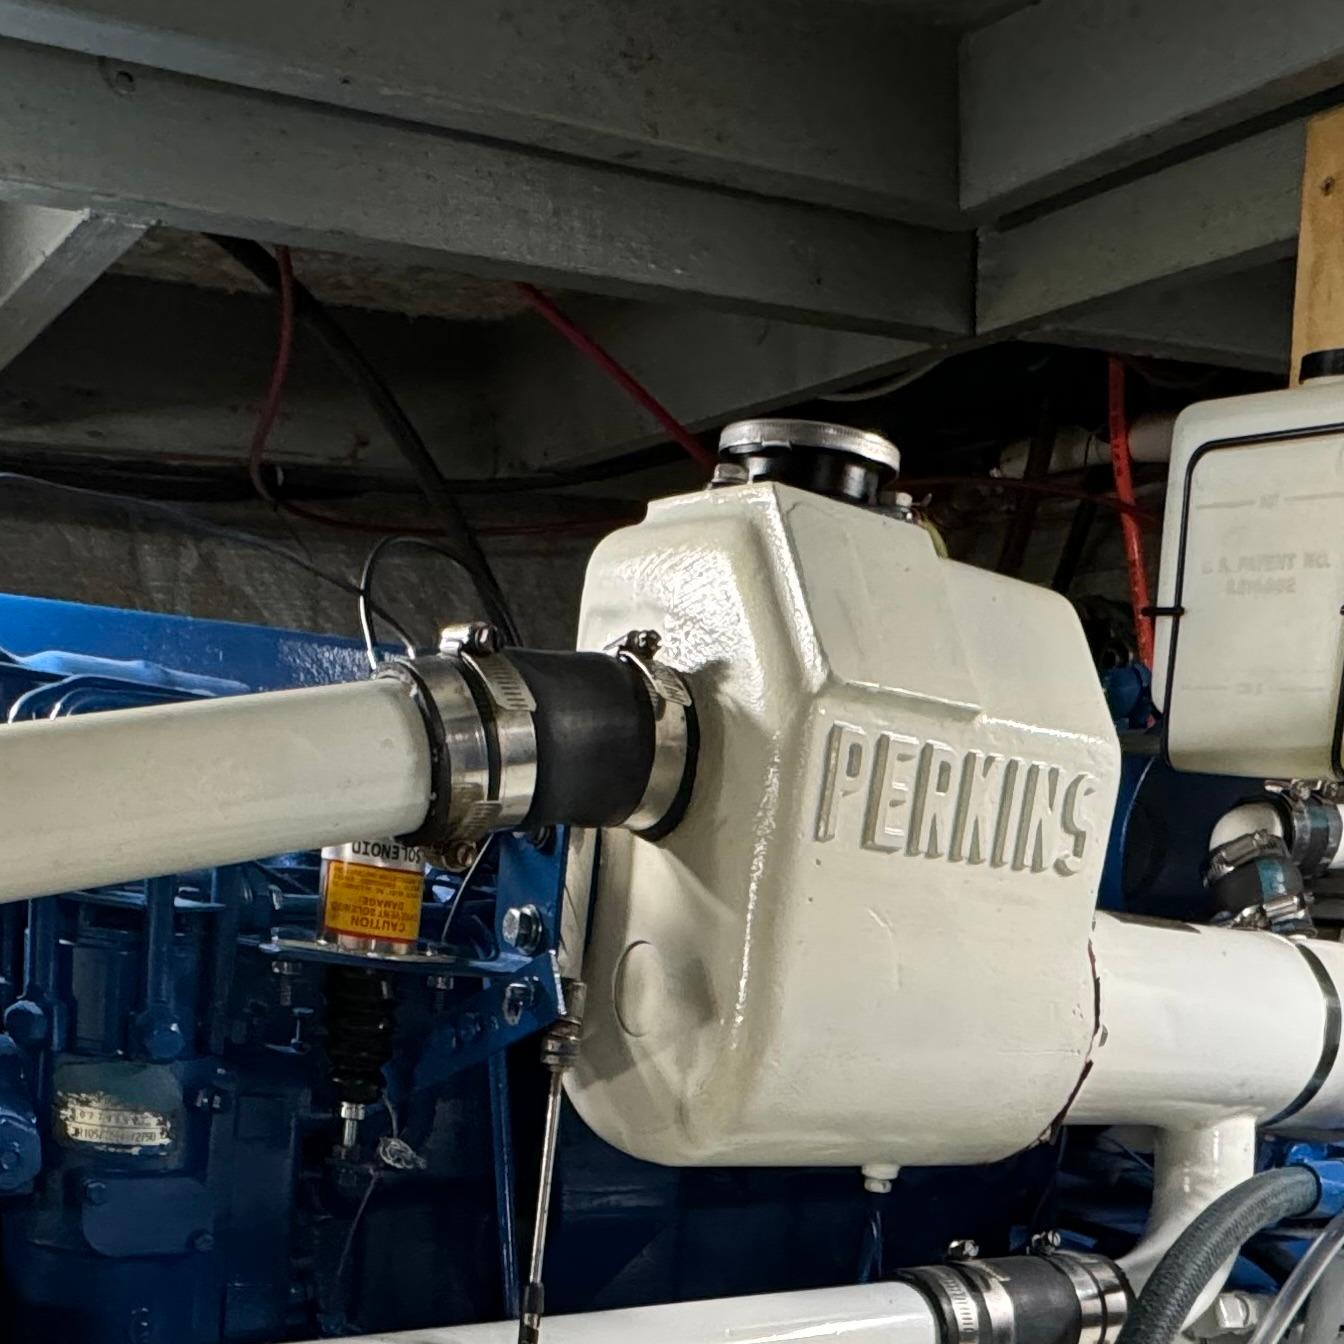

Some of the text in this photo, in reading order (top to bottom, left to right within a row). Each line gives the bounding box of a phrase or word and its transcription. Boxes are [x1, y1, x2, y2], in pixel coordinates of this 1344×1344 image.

[815, 720, 1097, 876] PERKINS
[351, 841, 421, 864] SOLENOID
[350, 914, 406, 933] CAUTION
